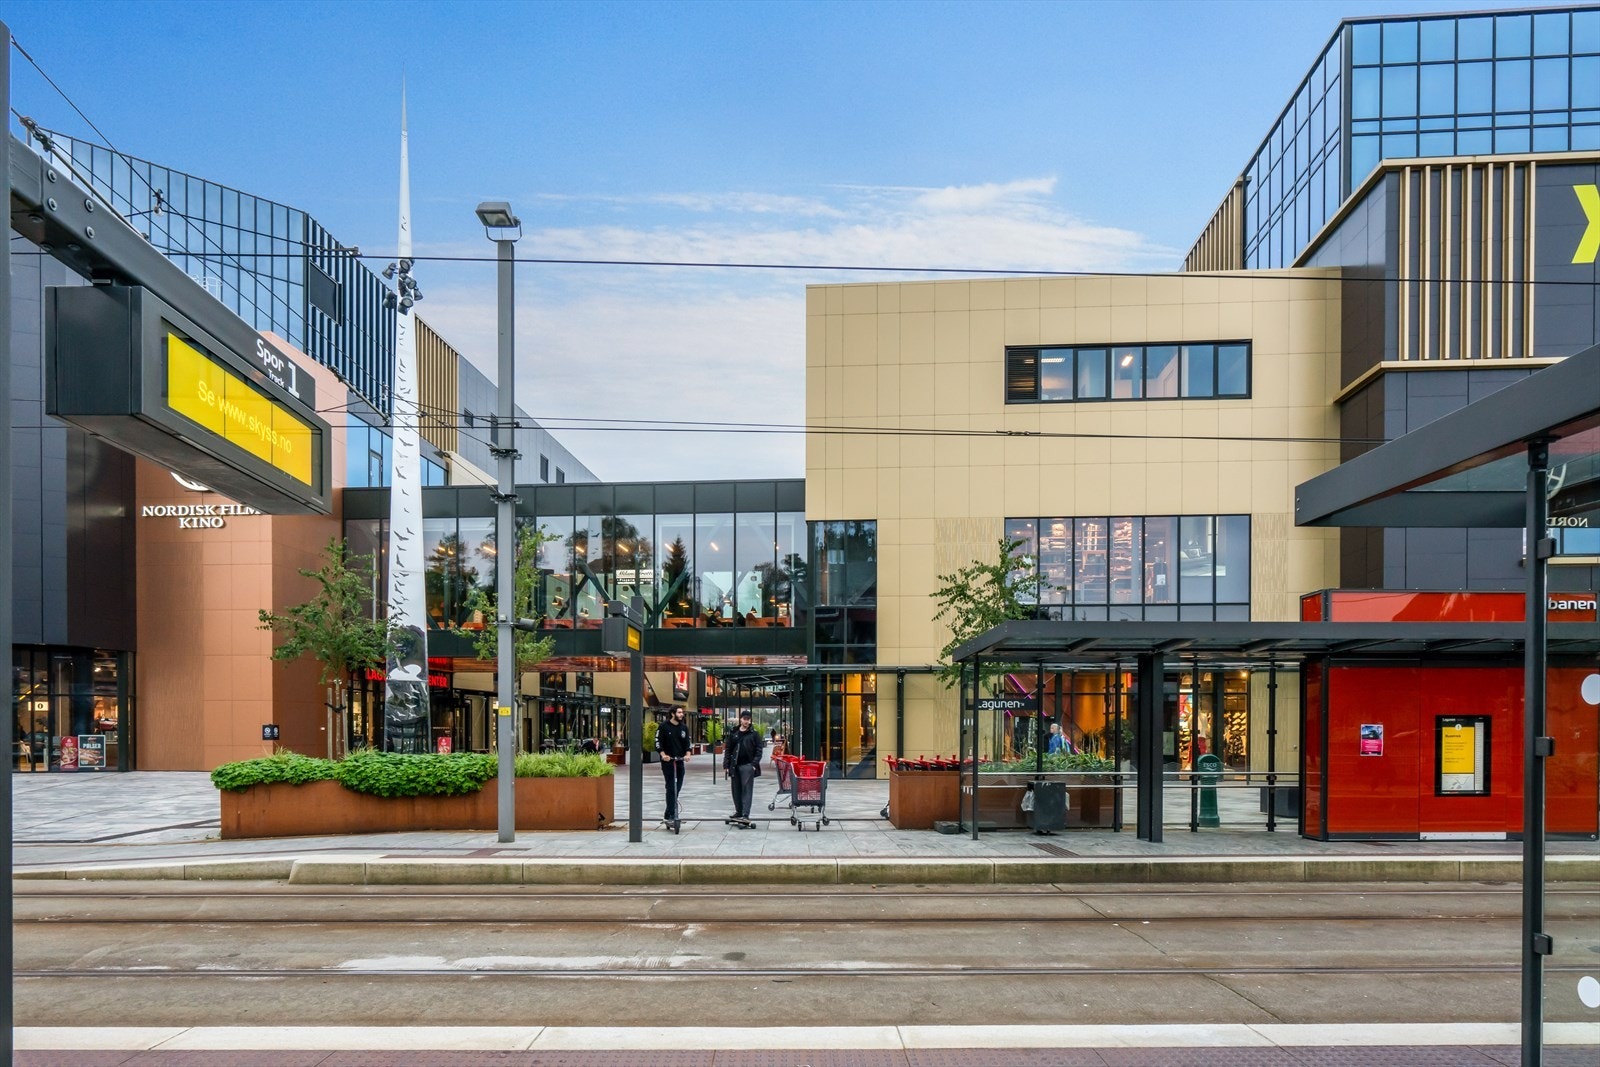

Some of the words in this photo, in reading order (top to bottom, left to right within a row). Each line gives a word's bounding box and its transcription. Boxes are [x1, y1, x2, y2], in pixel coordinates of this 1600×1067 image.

[256, 338, 284, 372] Spor
[268, 369, 285, 388] Track
[288, 361, 299, 399] 1
[198, 380, 215, 406] Se
[218, 396, 292, 454] www.skyss.no
[142, 504, 217, 517] NORDISK
[179, 516, 224, 528] KINO
[1548, 597, 1596, 610] banen
[428, 675, 448, 688] ENTER
